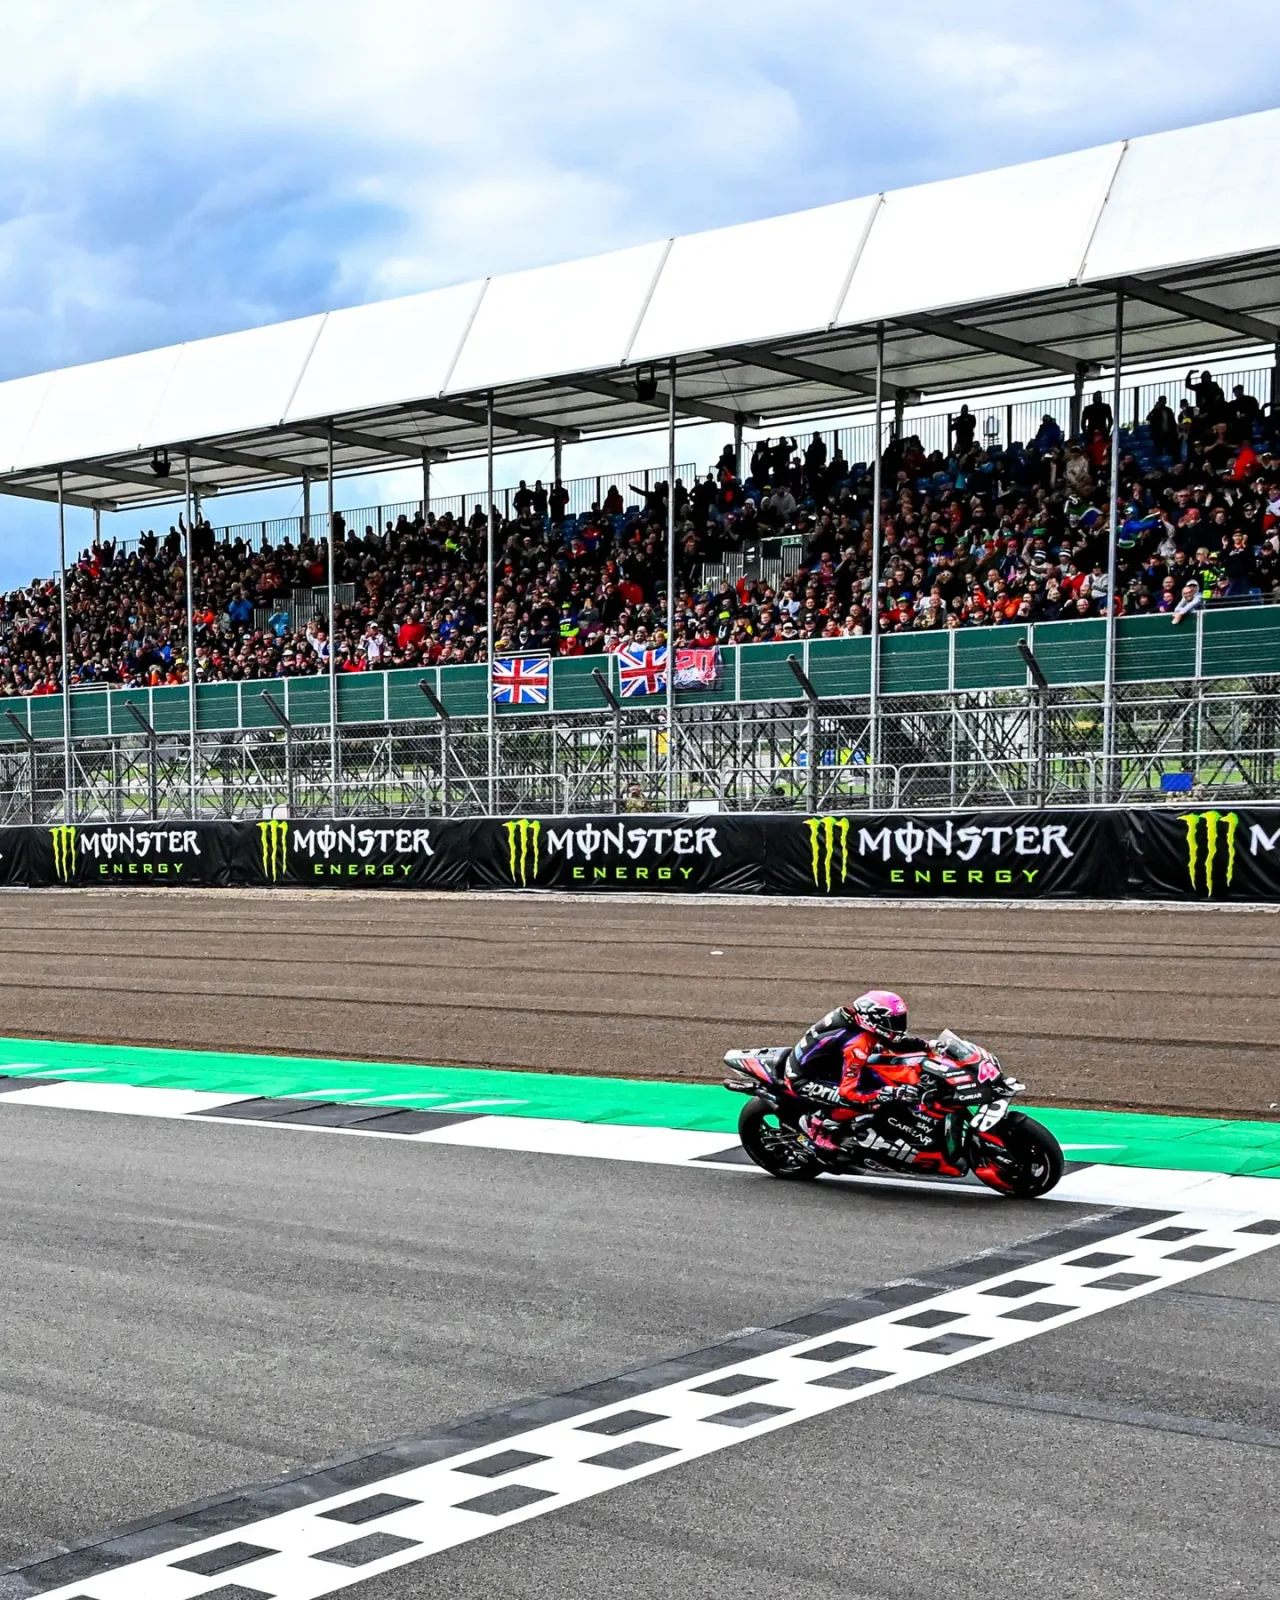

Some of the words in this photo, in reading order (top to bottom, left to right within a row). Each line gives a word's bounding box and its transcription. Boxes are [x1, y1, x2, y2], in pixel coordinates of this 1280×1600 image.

[80, 826, 202, 858] MONSTER
[293, 823, 435, 858] MONSTER
[547, 822, 722, 859] MONSTER
[858, 820, 1075, 861] MONSTER
[99, 863, 184, 874] ENERGY
[313, 863, 413, 876] ENERGY
[573, 867, 694, 879] ENERGY
[890, 870, 1040, 883] ENERGY
